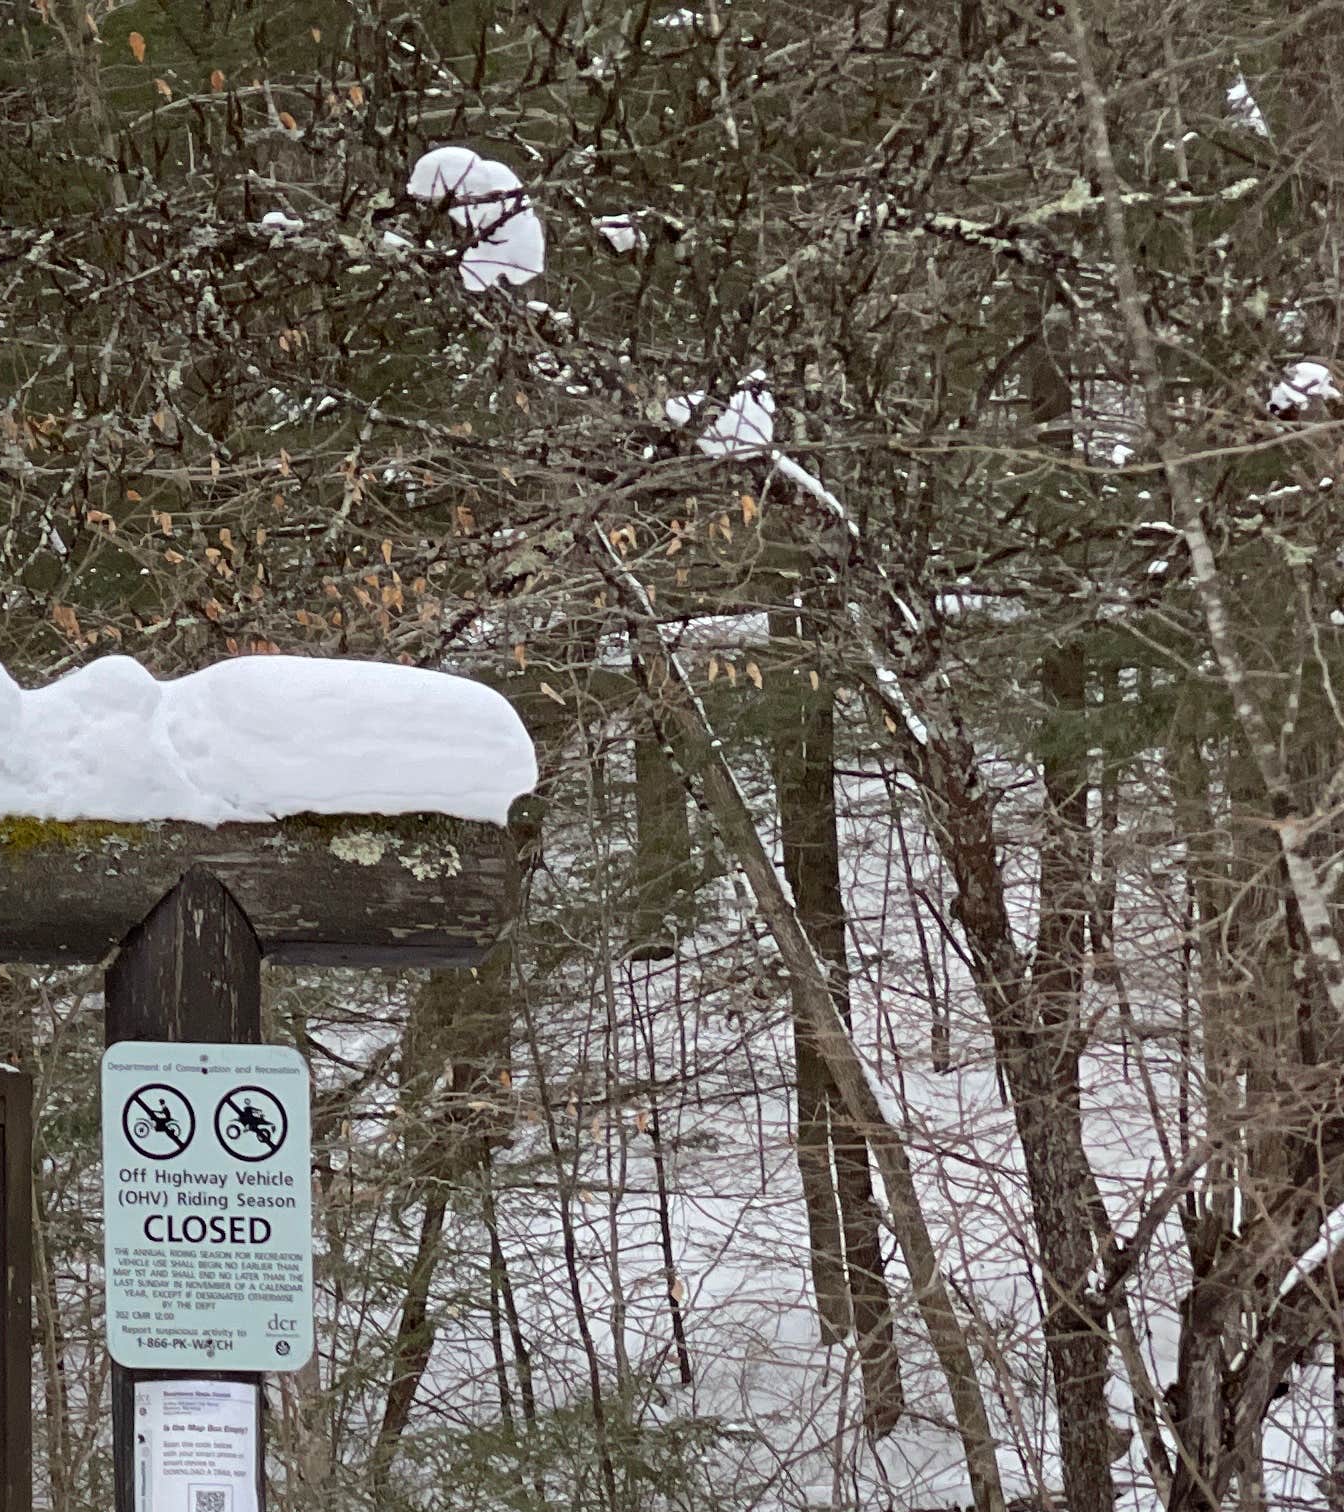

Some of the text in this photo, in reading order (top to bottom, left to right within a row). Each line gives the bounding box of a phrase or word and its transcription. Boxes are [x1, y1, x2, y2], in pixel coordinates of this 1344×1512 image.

[107, 1062, 159, 1072] Department
[163, 1063, 172, 1072] of
[235, 1066, 251, 1074] and
[255, 1066, 300, 1075] Recreation
[119, 1168, 294, 1188] Off Highway Vehicle
[118, 1189, 297, 1209] (OHV) Riding Season
[143, 1214, 272, 1244] CLOSED
[114, 1248, 129, 1256] THE
[133, 1248, 165, 1257] ANNUAL
[170, 1249, 197, 1258] RIDING
[200, 1250, 232, 1259] SEASON
[235, 1251, 251, 1260] FOR
[119, 1258, 149, 1267] VEHICLE
[153, 1259, 167, 1267] USE
[171, 1260, 194, 1268] SHALL
[225, 1261, 238, 1270] NO
[241, 1262, 272, 1270] EARLIER
[276, 1263, 299, 1271] THAN
[113, 1268, 131, 1276] MAY
[150, 1269, 168, 1277] AND
[171, 1270, 194, 1278] SHALL
[219, 1271, 232, 1280] NO
[235, 1272, 259, 1280] LATER
[262, 1272, 286, 1281] THAN
[114, 1278, 134, 1287] LAST
[235, 1282, 245, 1290] OF
[248, 1282, 256, 1290] A
[258, 1283, 303, 1292] CALENDAR
[152, 1290, 182, 1298] EXCEPT
[177, 1301, 192, 1309] THE
[267, 1313, 297, 1331] dcr
[122, 1325, 247, 1338] Report suspicious activity to
